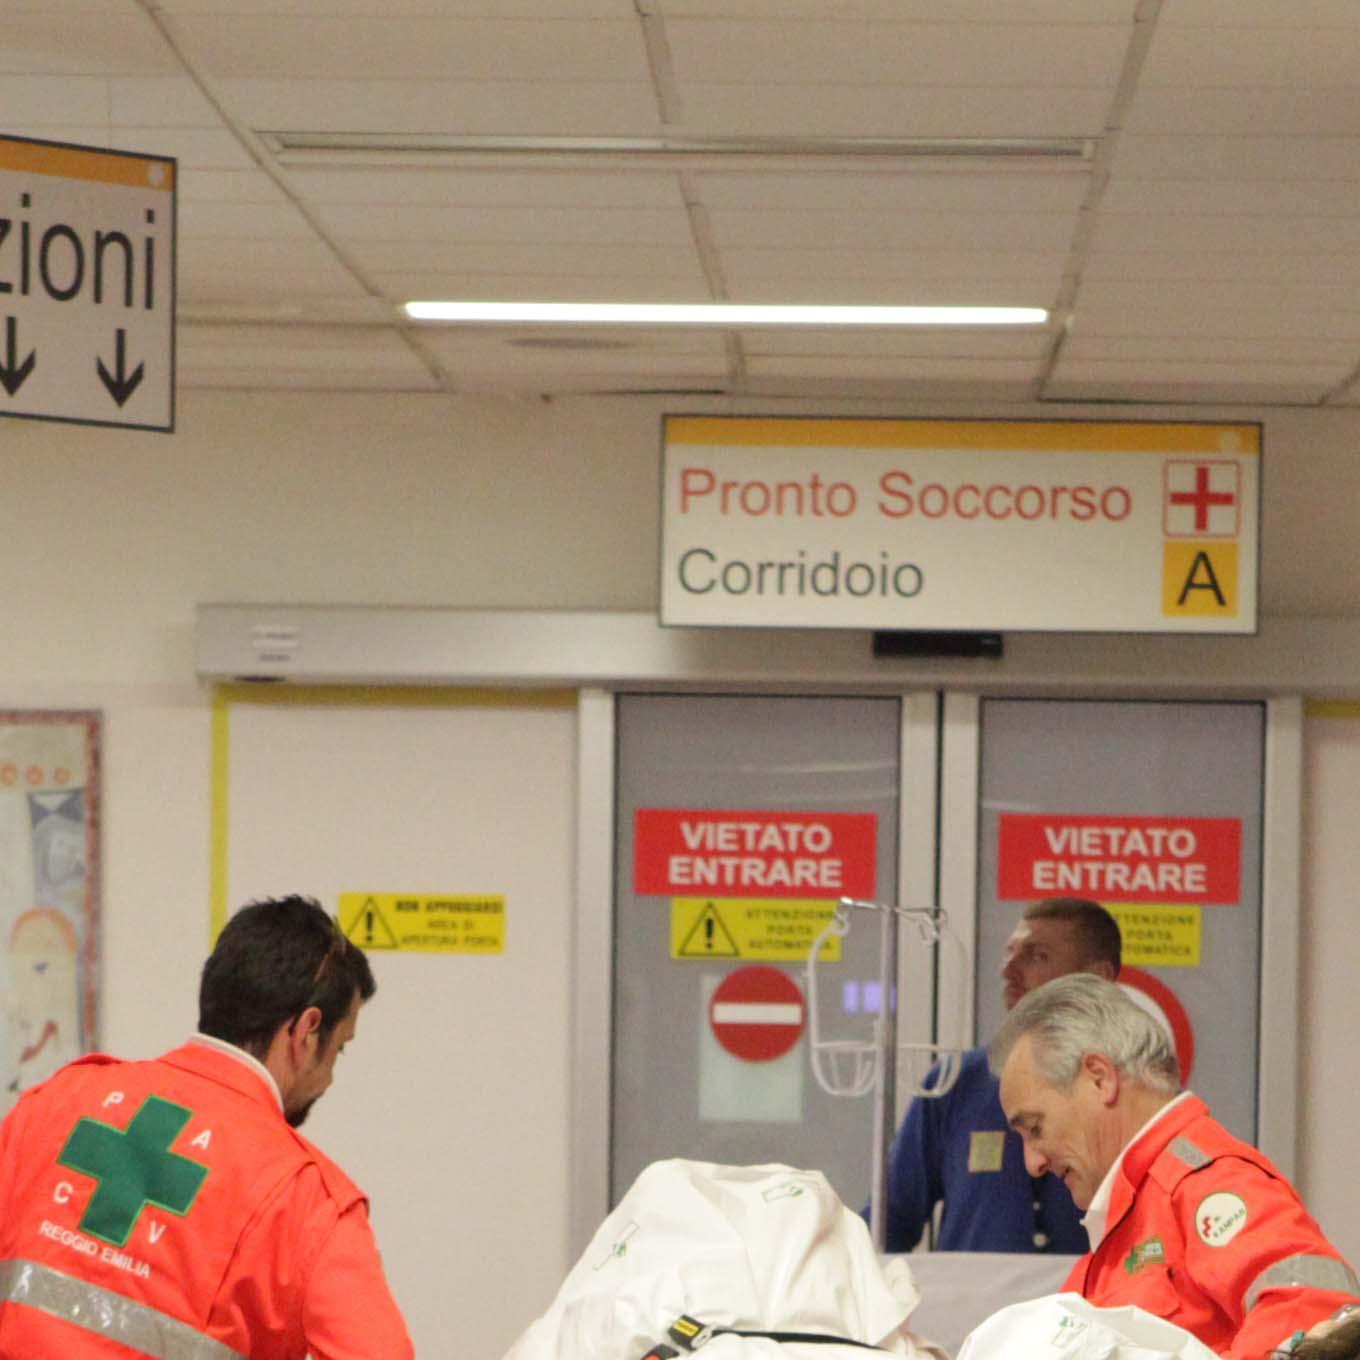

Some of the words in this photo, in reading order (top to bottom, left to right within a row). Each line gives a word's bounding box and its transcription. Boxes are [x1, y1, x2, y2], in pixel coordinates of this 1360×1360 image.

[679, 468, 858, 518] Pronto
[878, 471, 1133, 522] Soccorso
[677, 547, 924, 599] Corridoio
[1176, 551, 1227, 607] A
[679, 821, 833, 854] VIETATO
[1044, 826, 1198, 859] VIETATO
[668, 856, 844, 888] ENTRARE
[1032, 860, 1208, 893] ENTRARE
[101, 1090, 125, 1109] P
[191, 1129, 213, 1151] A
[52, 1181, 75, 1205] C
[148, 1220, 167, 1245] V
[37, 1219, 98, 1258] REGGIO
[100, 1246, 152, 1280] EMILIA
